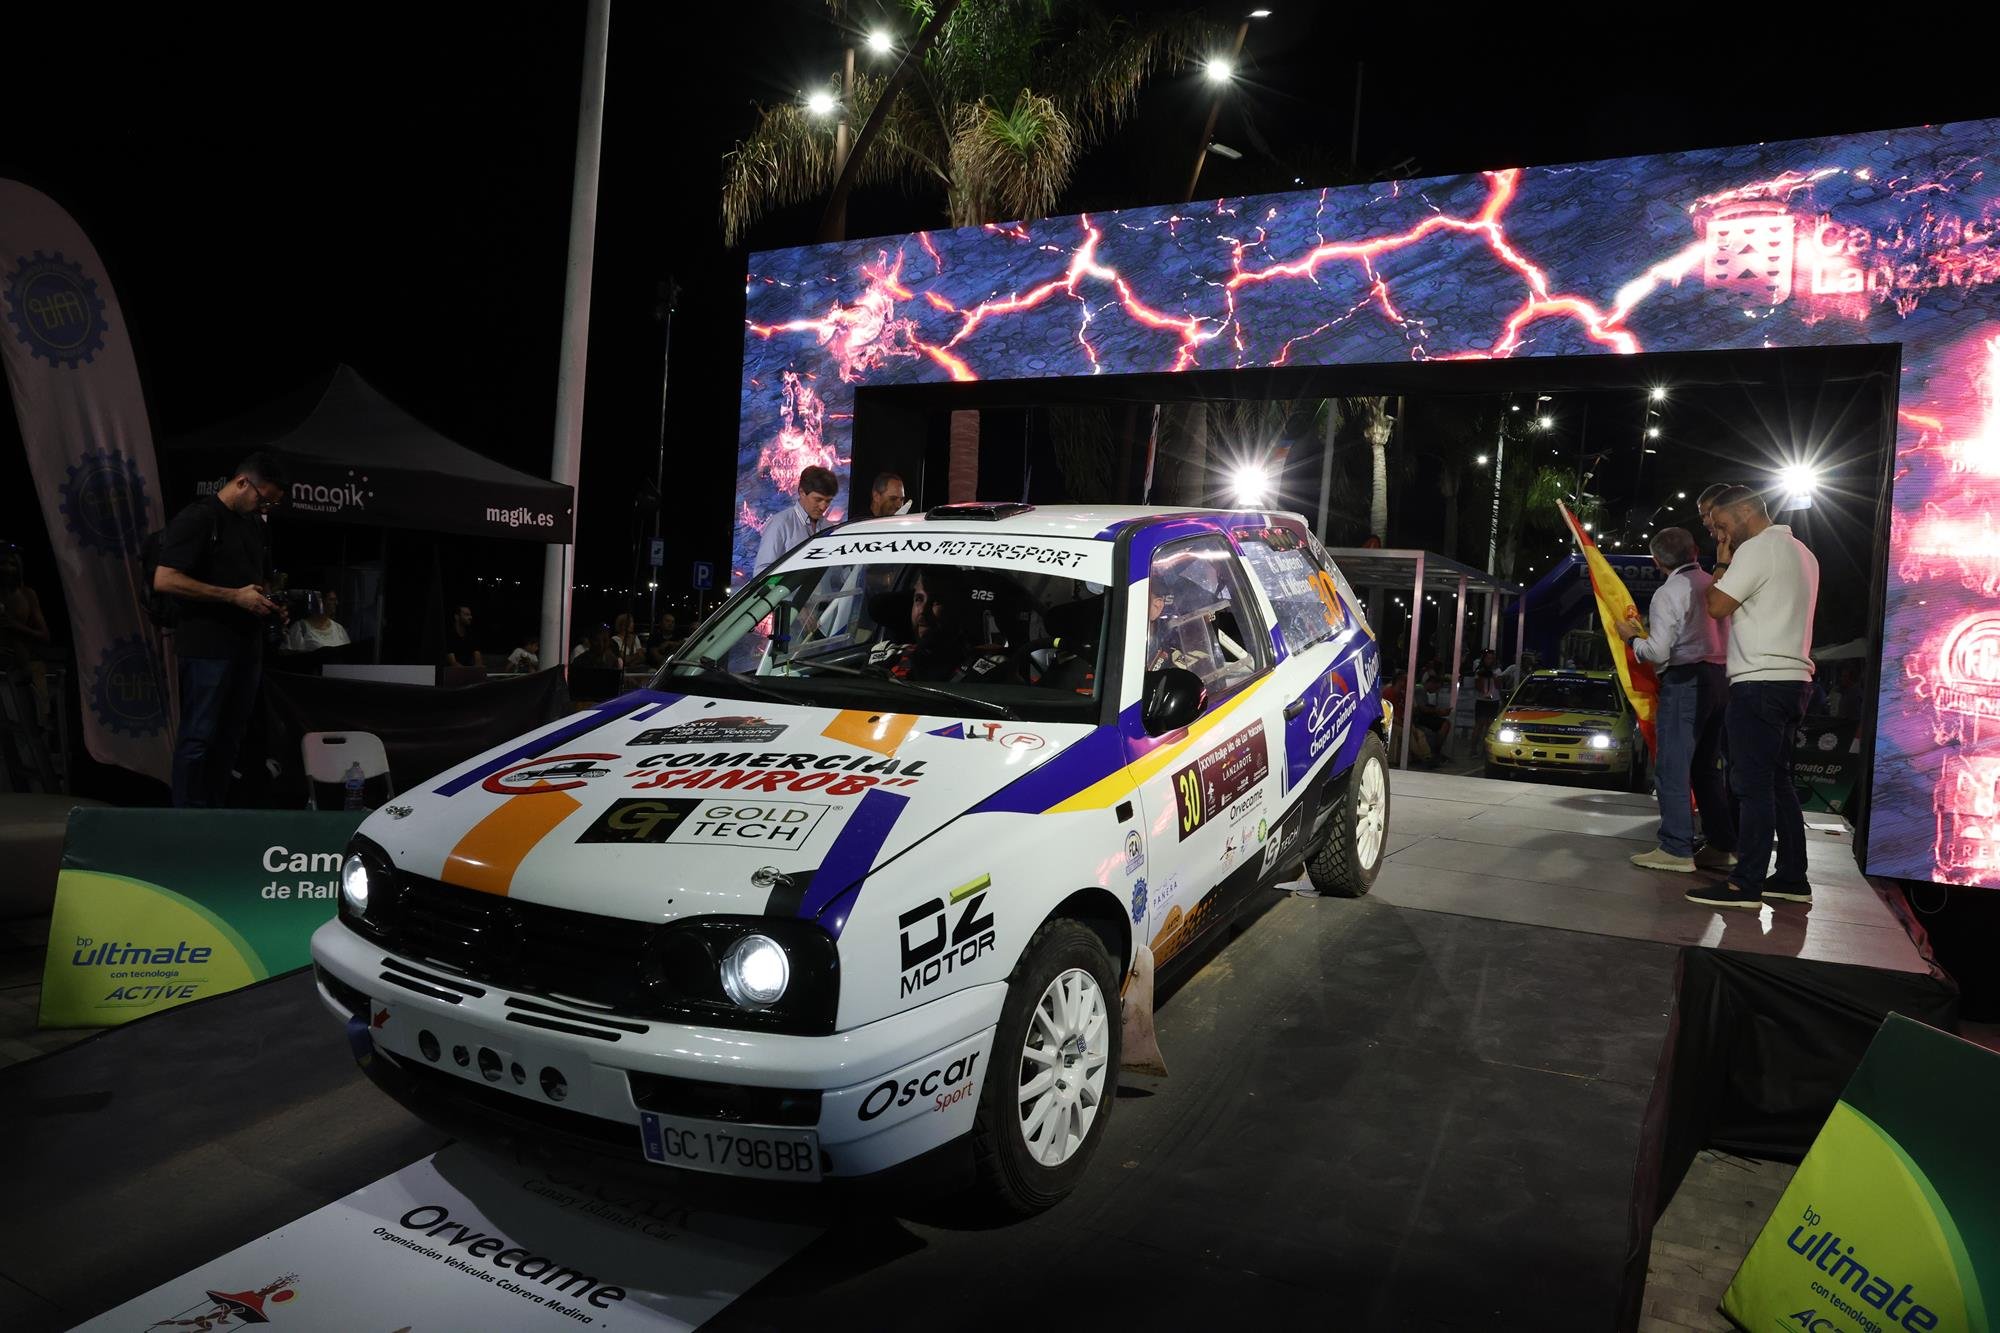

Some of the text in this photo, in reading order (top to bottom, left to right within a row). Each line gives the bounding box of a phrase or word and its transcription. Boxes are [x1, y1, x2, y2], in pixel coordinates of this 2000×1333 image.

[196, 476, 230, 497] magi
[292, 483, 365, 511] magik
[486, 507, 554, 527] magik.es
[934, 541, 1088, 568] MOTORSPORT
[698, 565, 709, 586] P
[1307, 570, 1345, 625] 30
[1336, 700, 1357, 733] pintura
[635, 752, 929, 777] COMERCIAL
[1222, 753, 1252, 781] LANZAROTE
[1793, 763, 1842, 775] onato BP
[1180, 769, 1201, 833] 30
[704, 806, 809, 824] GOLD
[693, 821, 800, 842] TECH
[262, 846, 344, 873] Cam
[261, 881, 339, 899] de Rall
[899, 873, 994, 973] DZ
[72, 941, 212, 966] ultimate
[76, 936, 93, 947] bp
[900, 929, 996, 999] MOTOR
[104, 985, 198, 1001] ACTIVE
[857, 1050, 980, 1122] Oscar
[933, 1080, 974, 1112] Sport
[1803, 1205, 1821, 1227] bp
[642, 1222, 679, 1241] Car
[399, 1205, 626, 1309] Orvecame
[1787, 1225, 1939, 1333] ultimate
[1810, 1280, 1830, 1299] con
[496, 1278, 546, 1304] Cabrera
[543, 1299, 593, 1324] Medina
